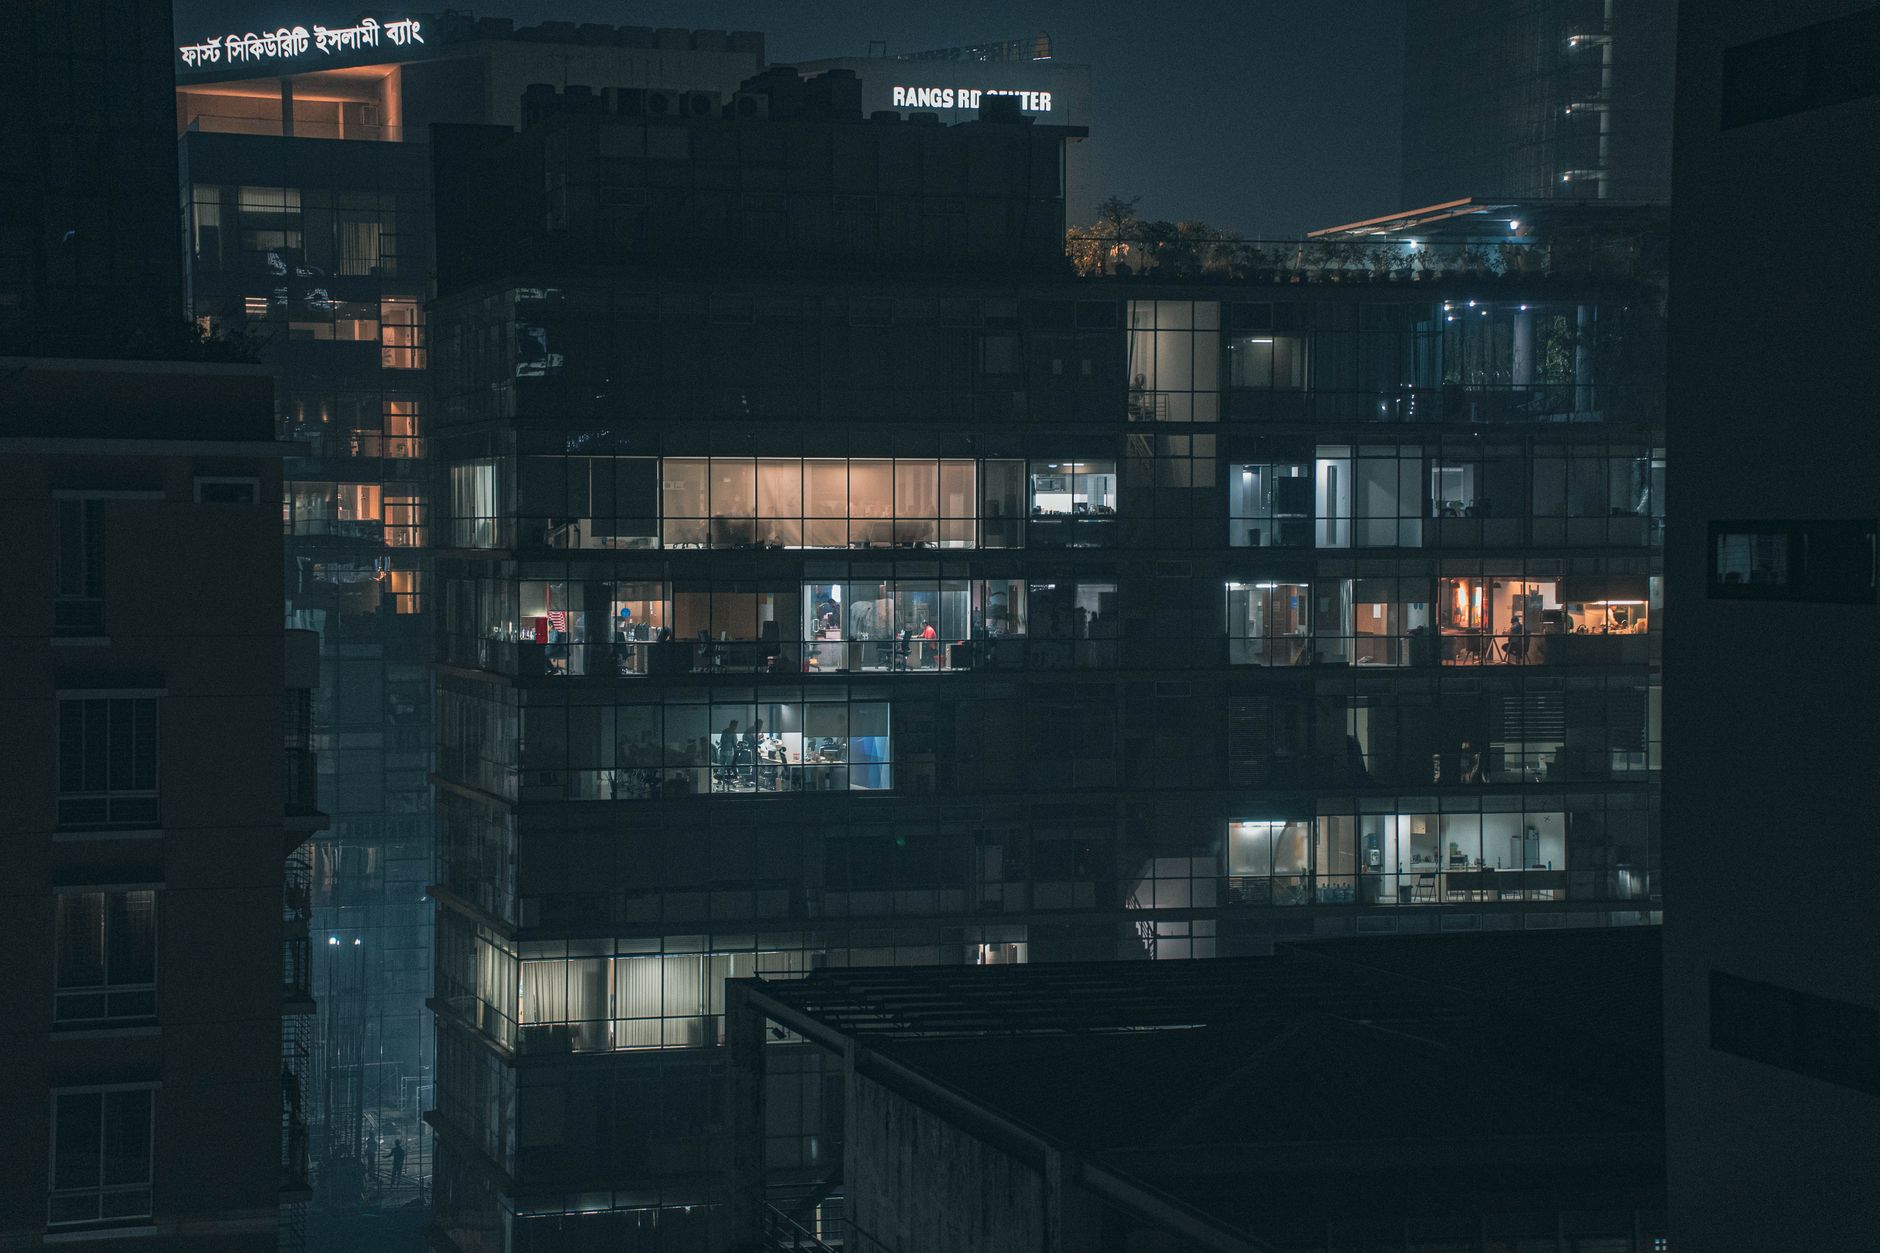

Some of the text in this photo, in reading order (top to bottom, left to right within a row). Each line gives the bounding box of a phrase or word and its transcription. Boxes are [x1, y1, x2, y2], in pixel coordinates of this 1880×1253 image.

[179, 37, 223, 68] ফার্স্ট
[225, 26, 311, 64] সিকিউরিটি
[313, 17, 381, 55] ইসলামী
[893, 86, 954, 109] RANGS
[986, 89, 1052, 112] TER
